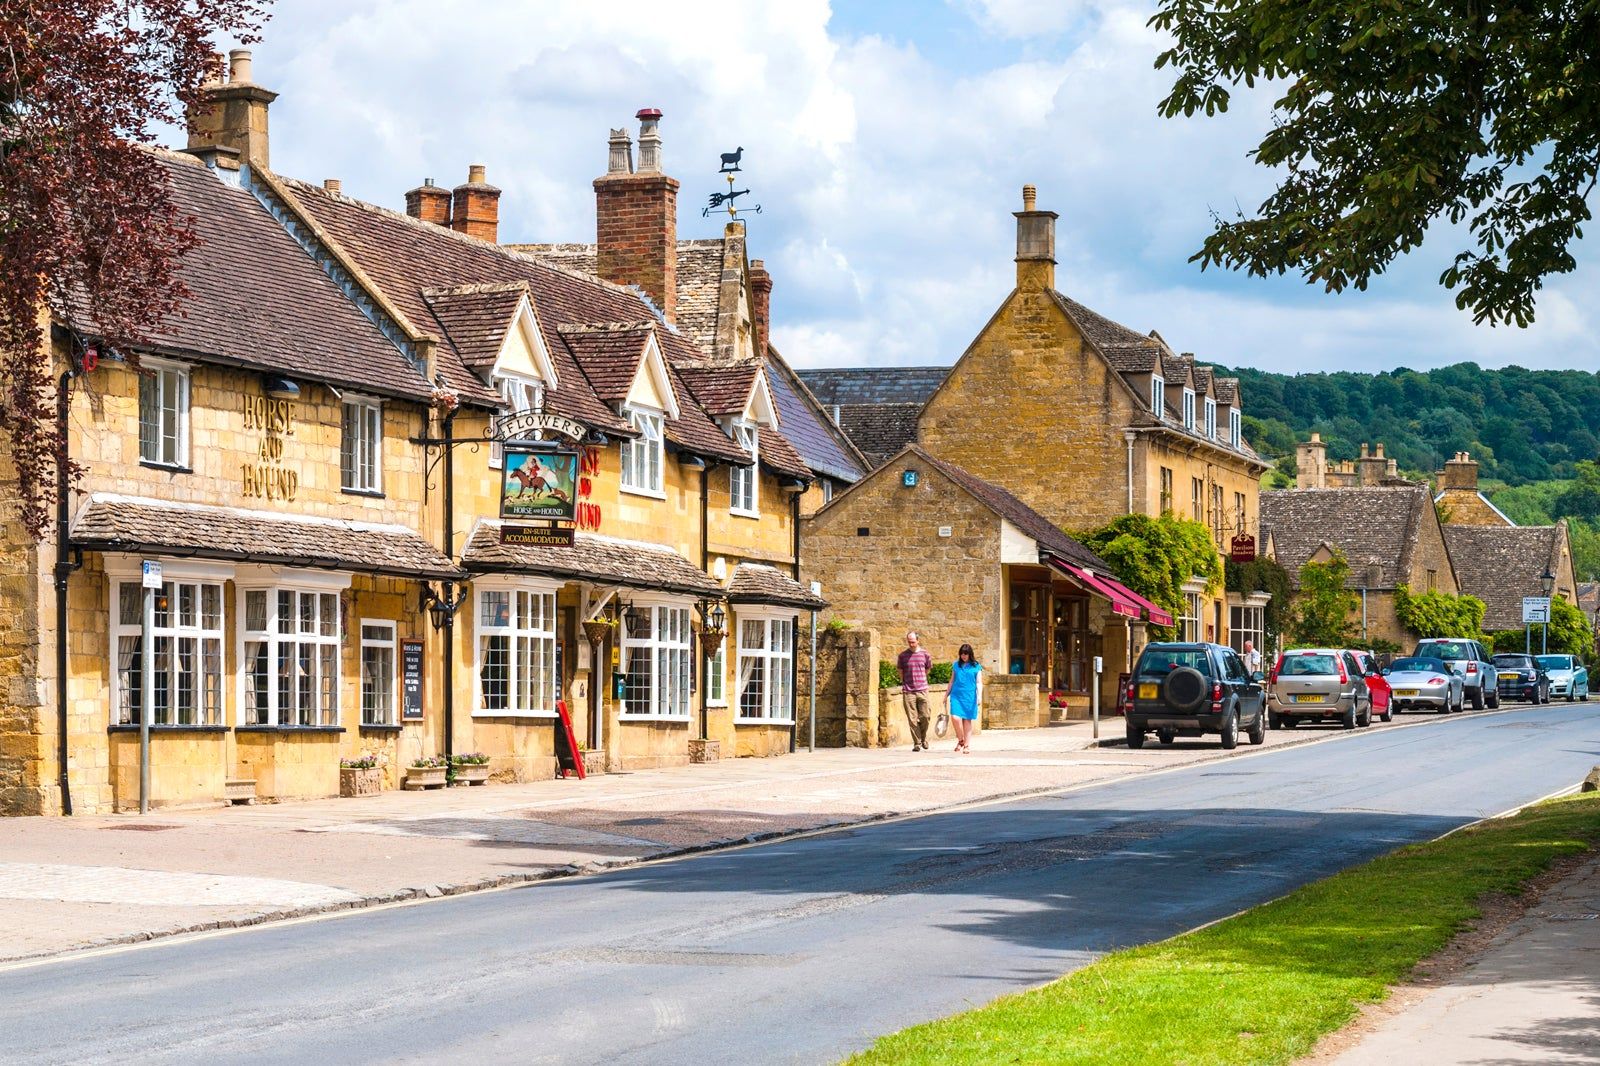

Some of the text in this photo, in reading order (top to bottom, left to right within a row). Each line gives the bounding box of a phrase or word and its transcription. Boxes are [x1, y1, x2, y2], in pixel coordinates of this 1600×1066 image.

[244, 395, 296, 435] HORSE
[506, 414, 582, 437] FLOWERS
[259, 437, 283, 463] AND
[240, 464, 298, 502] HOUND
[513, 506, 532, 515] HORSE
[541, 508, 564, 516] HOUND
[505, 535, 569, 544] ACCOMMODATION
[523, 528, 551, 536] EN-SUITE
